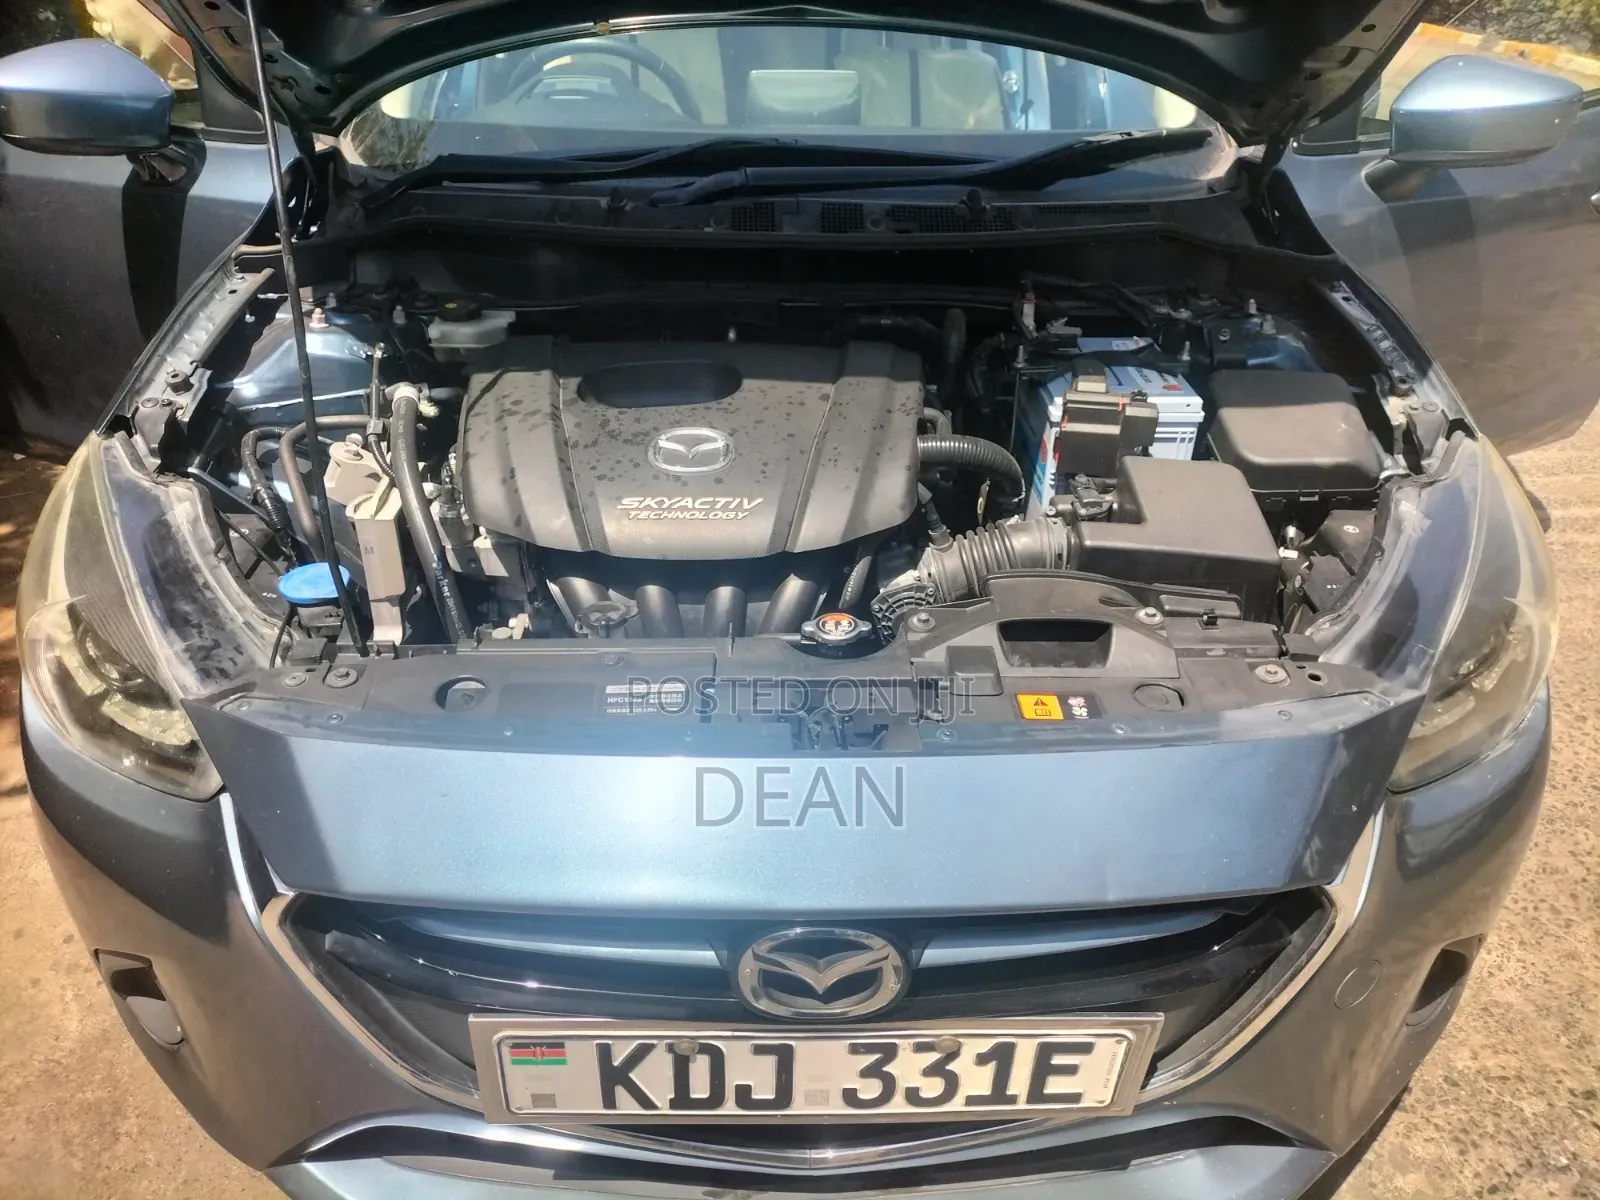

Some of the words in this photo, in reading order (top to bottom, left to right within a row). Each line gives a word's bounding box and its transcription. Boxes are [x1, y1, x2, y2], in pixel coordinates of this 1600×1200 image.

[616, 497, 764, 510] SKYACTIV
[627, 510, 750, 521] TECHNOLOGY
[595, 1041, 795, 1111] KDJ
[842, 1040, 1095, 1109] 331E
